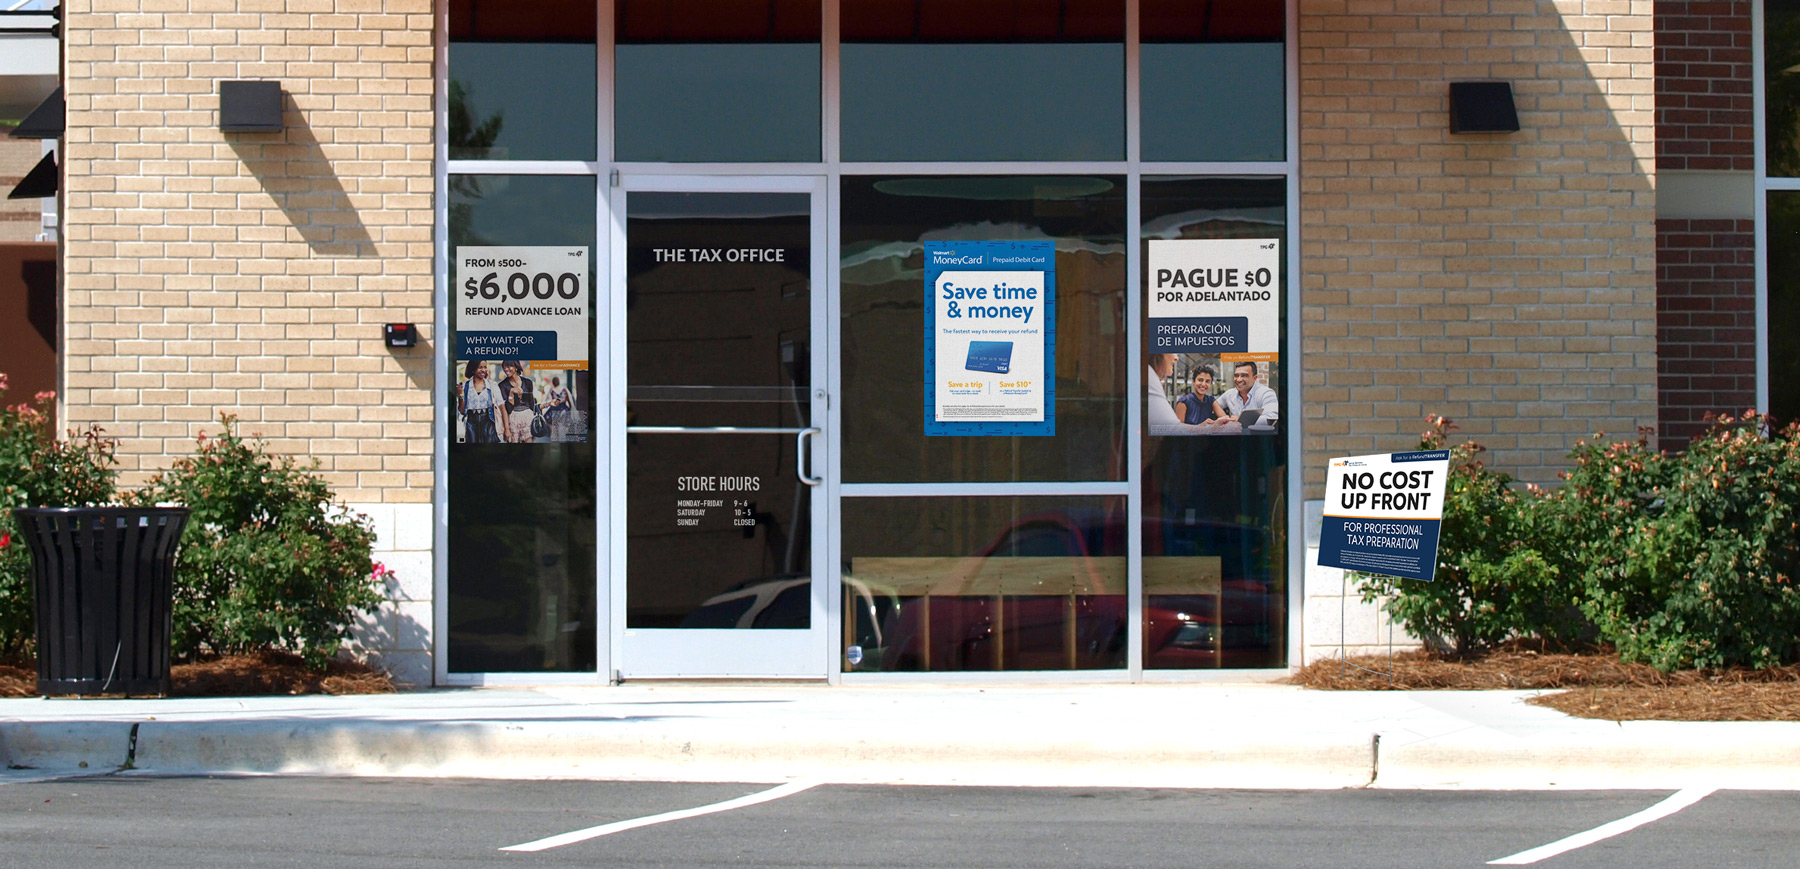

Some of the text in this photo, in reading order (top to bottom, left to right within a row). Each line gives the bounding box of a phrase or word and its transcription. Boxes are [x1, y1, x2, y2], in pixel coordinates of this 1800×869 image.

[653, 248, 785, 262] THE TAX OFFICE
[992, 256, 1015, 264] Prepaid
[465, 258, 496, 267] FROM
[1157, 267, 1272, 288] PAGUE $0
[942, 282, 1038, 300] Save time
[1157, 290, 1271, 302] POR ADELANTADO
[465, 307, 581, 316] REFUND ADVANCE LOAN
[947, 300, 1034, 324] & money
[1157, 322, 1231, 335] PREPARACIÓN
[465, 336, 534, 345] WHY WAIT FOR
[1157, 336, 1235, 347] DE IMPUESTOS
[465, 347, 519, 355] A REFUND?!
[970, 381, 983, 390] trip
[677, 476, 760, 491] STORE HOURS
[1342, 470, 1434, 490] NO COST
[1341, 492, 1431, 511] UP FRONT
[1343, 522, 1423, 536] FOR PROFESSIONAL
[1347, 534, 1420, 550] TAX PREPARATION
